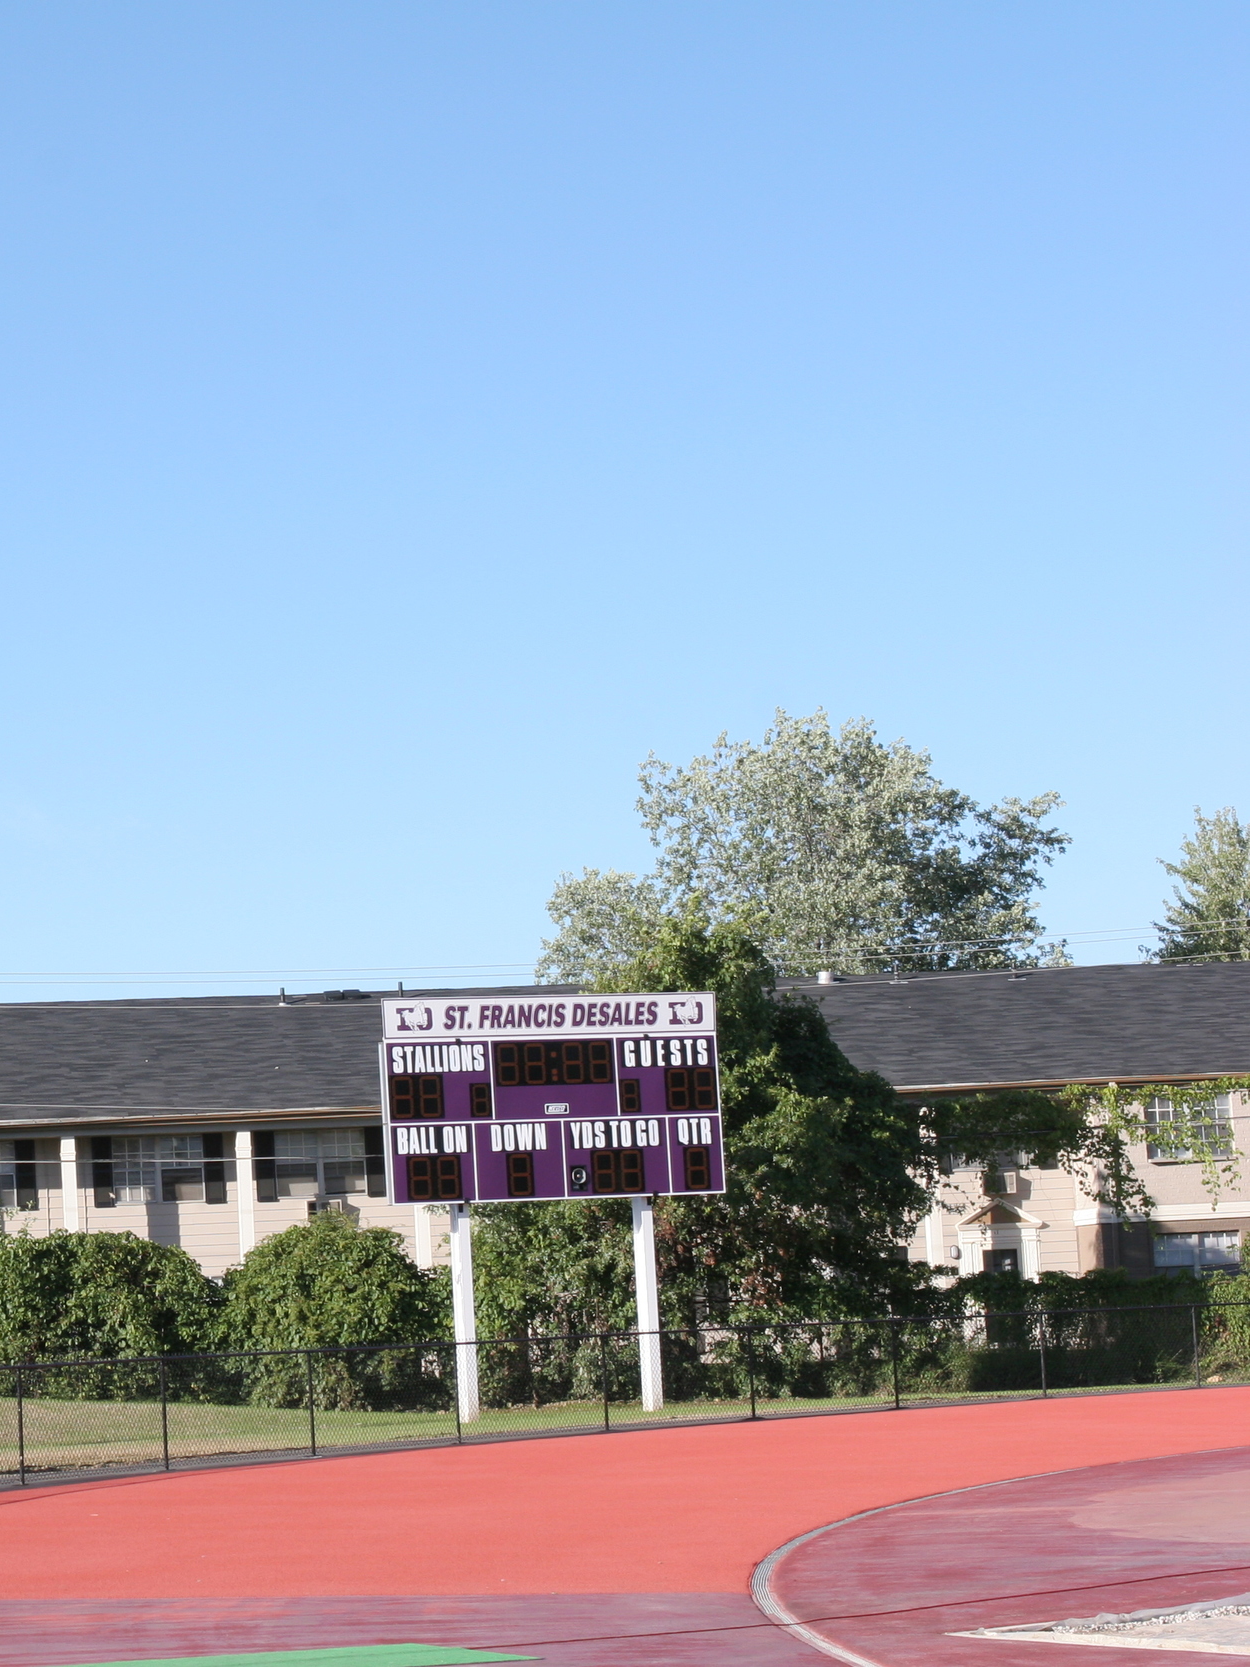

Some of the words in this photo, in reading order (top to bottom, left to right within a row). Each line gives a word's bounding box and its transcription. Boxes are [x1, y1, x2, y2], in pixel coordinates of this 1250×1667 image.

[443, 1005, 472, 1030] ST.
[479, 1003, 565, 1029] FRANCIS
[572, 1001, 658, 1028] DESALES
[391, 1044, 485, 1074] STALLIONS
[623, 1039, 709, 1067] GUESTS
[396, 1126, 438, 1154] BALL
[442, 1125, 468, 1153] ON
[491, 1123, 547, 1151] DOWN
[570, 1121, 606, 1149] YDS
[609, 1120, 633, 1148] TO
[635, 1119, 660, 1147] GO
[677, 1118, 712, 1145] QTR
